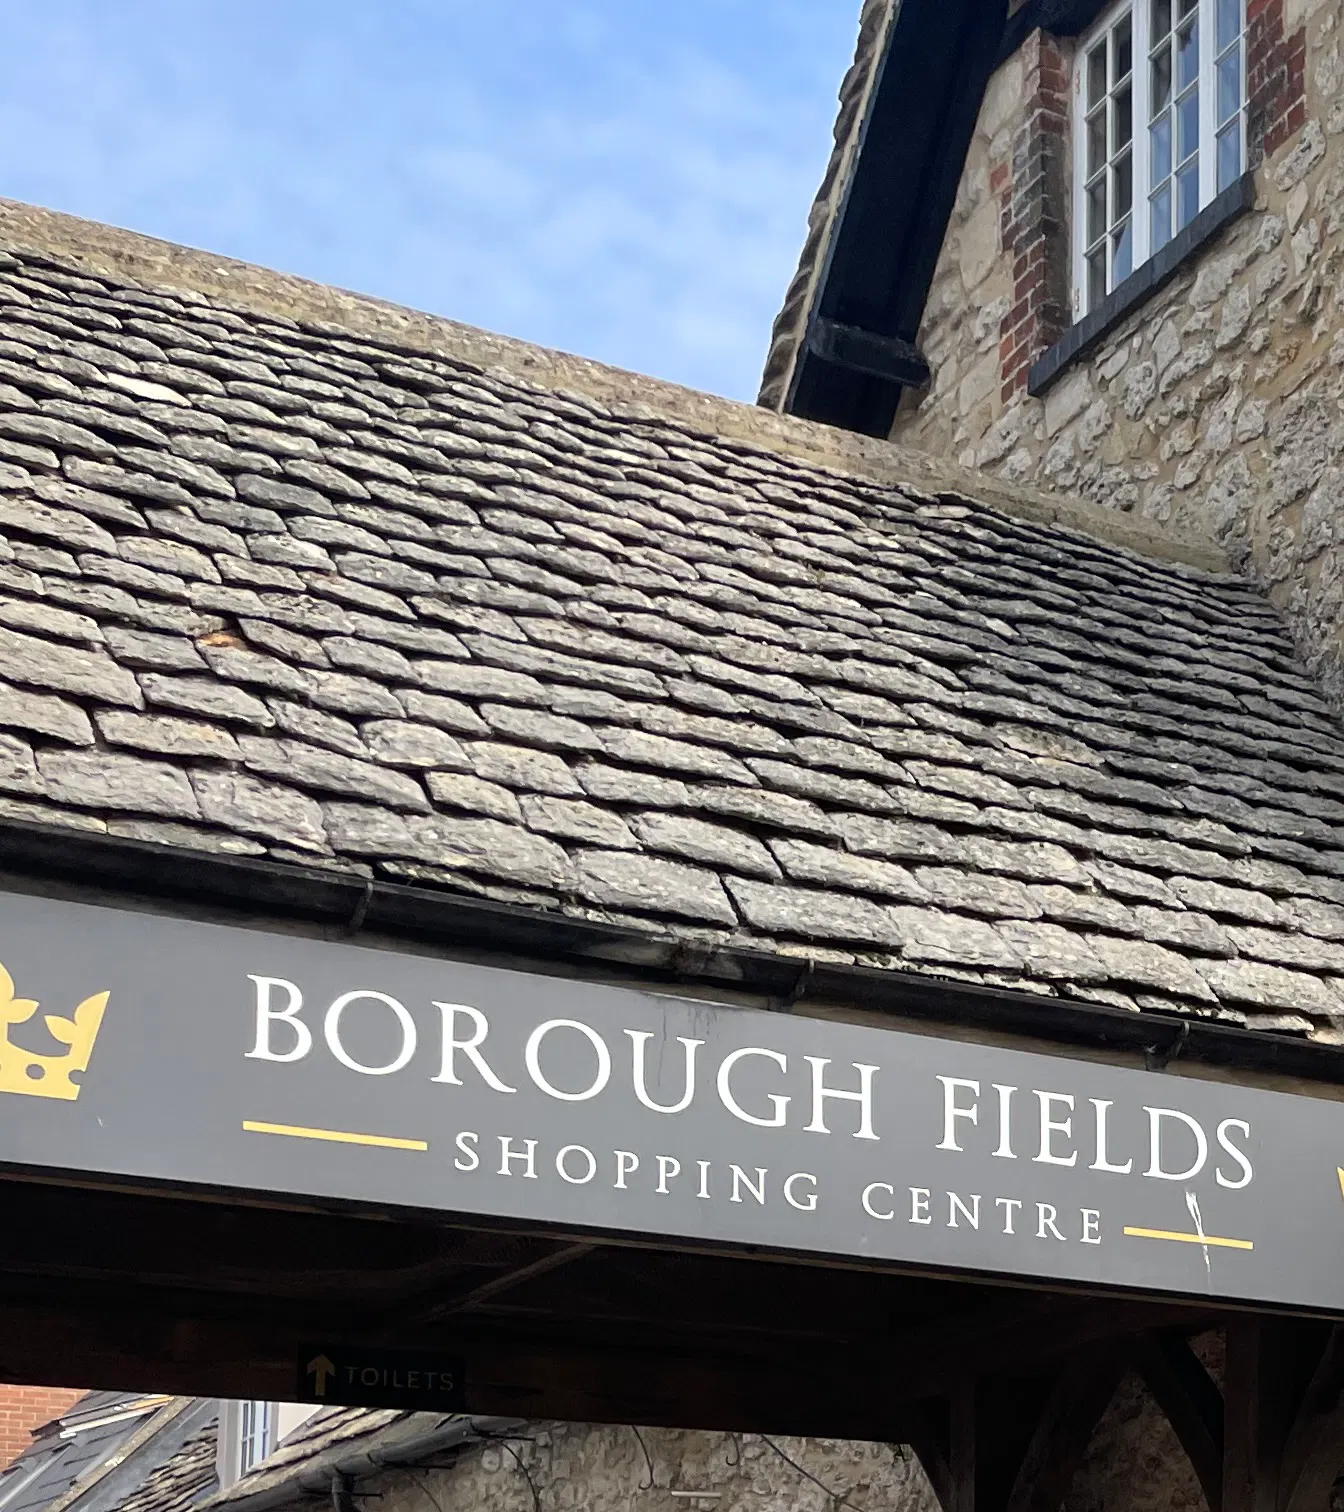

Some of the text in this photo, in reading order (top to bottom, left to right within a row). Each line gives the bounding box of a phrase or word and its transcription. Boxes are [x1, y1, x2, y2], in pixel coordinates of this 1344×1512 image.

[244, 973, 1254, 1189] BOROUGH FIELDS
[453, 1131, 1103, 1245] SHOPPING CENTRE
[343, 1366, 454, 1391] TOILETS
